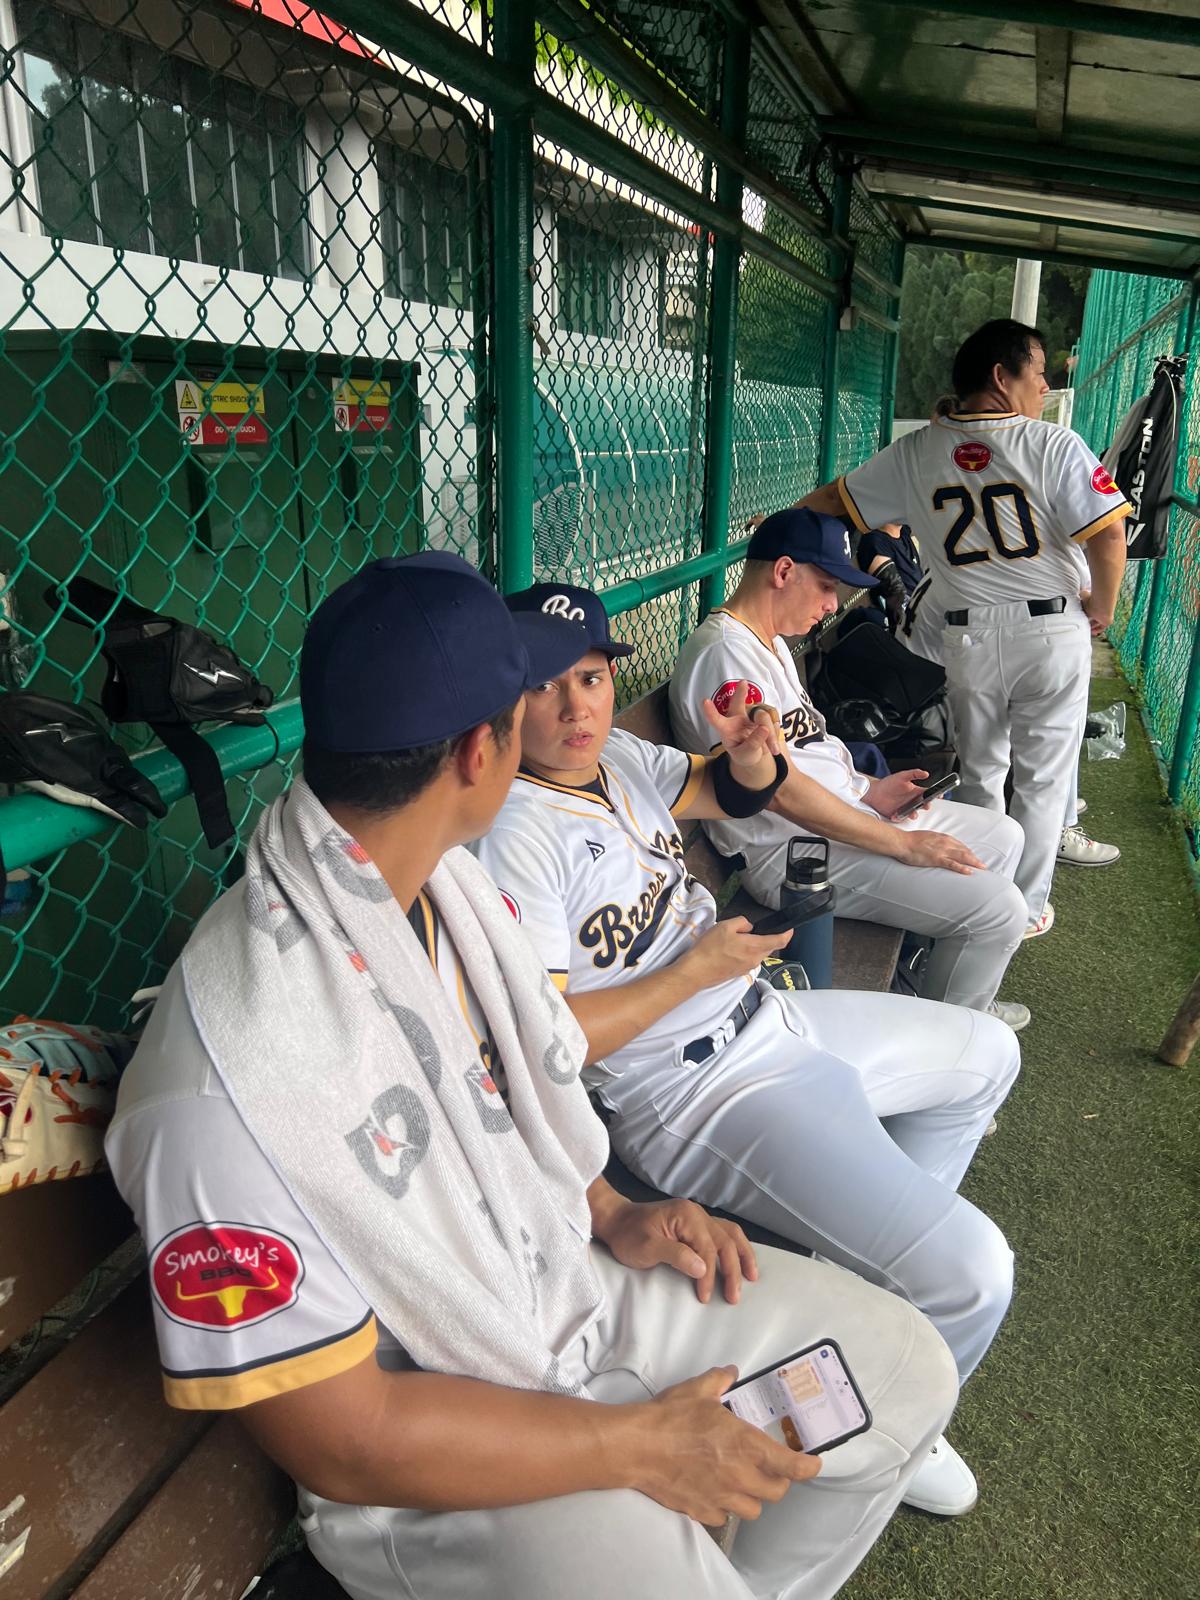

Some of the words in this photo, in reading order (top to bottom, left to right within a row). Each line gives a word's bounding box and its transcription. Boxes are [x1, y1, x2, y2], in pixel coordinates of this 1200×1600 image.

[1132, 415, 1154, 521] EASTON
[932, 482, 1040, 566] 20
[165, 1241, 280, 1276] Smokey's
[201, 1266, 253, 1280] BBQ
